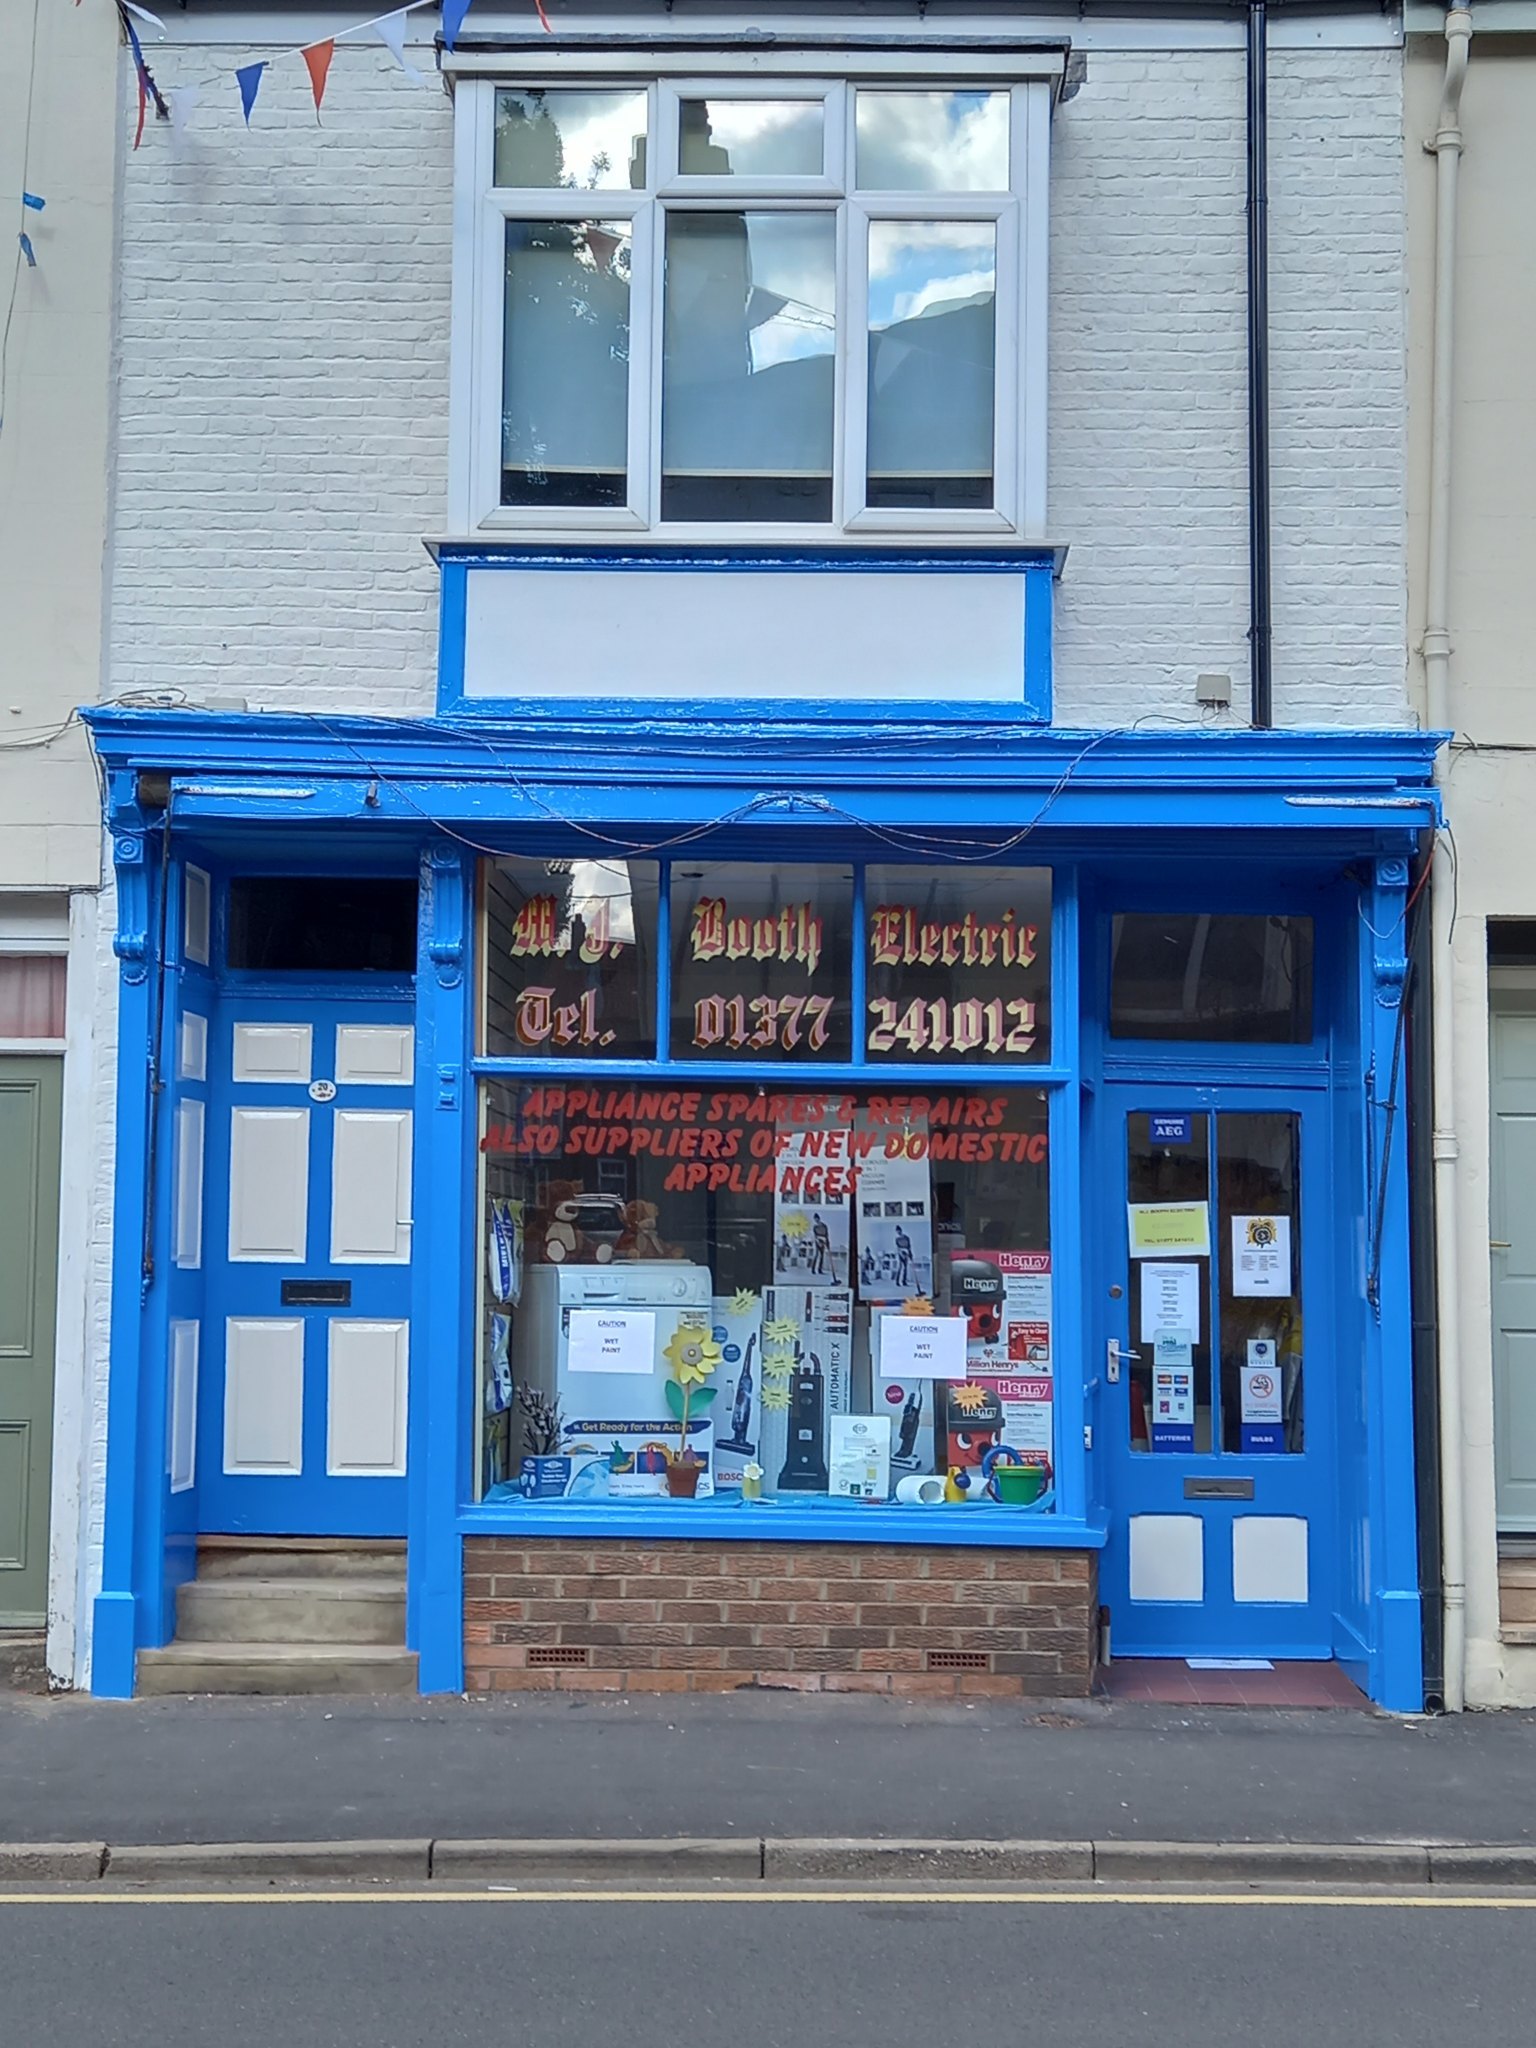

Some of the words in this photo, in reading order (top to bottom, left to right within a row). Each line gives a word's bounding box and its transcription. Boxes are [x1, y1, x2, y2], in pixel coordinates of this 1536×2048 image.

[690, 896, 823, 977] Booth
[870, 904, 1038, 968] Electric
[515, 986, 617, 1047] Tel.
[692, 994, 834, 1050] 01377
[868, 996, 1036, 1053] 241012
[521, 1088, 702, 1122] APPLIANCE
[706, 1093, 830, 1124] SPARES
[837, 1094, 857, 1125] &
[867, 1096, 1008, 1127] REPAIRS
[1155, 1126, 1183, 1136] AEG
[480, 1124, 560, 1154] ALSO
[565, 1126, 743, 1158] SUPPLIERS
[750, 1127, 793, 1159] OF
[800, 1131, 877, 1159] NEW
[884, 1131, 1047, 1164] DOMESTIC
[664, 1162, 863, 1196] APPLIANCES
[999, 1253, 1049, 1270] Henry
[964, 1278, 998, 1290] Henry
[598, 1320, 626, 1328] CAUTION
[909, 1325, 938, 1333] CAUTION
[833, 1342, 840, 1350] X
[991, 1361, 1019, 1371] Henrys
[830, 1351, 840, 1409] AUTOMATIC
[998, 1380, 1048, 1398] Henry
[582, 1423, 598, 1431] Get
[600, 1423, 628, 1433] Ready
[630, 1423, 643, 1431] for
[646, 1423, 660, 1431] the
[717, 1473, 744, 1481] BOSC
